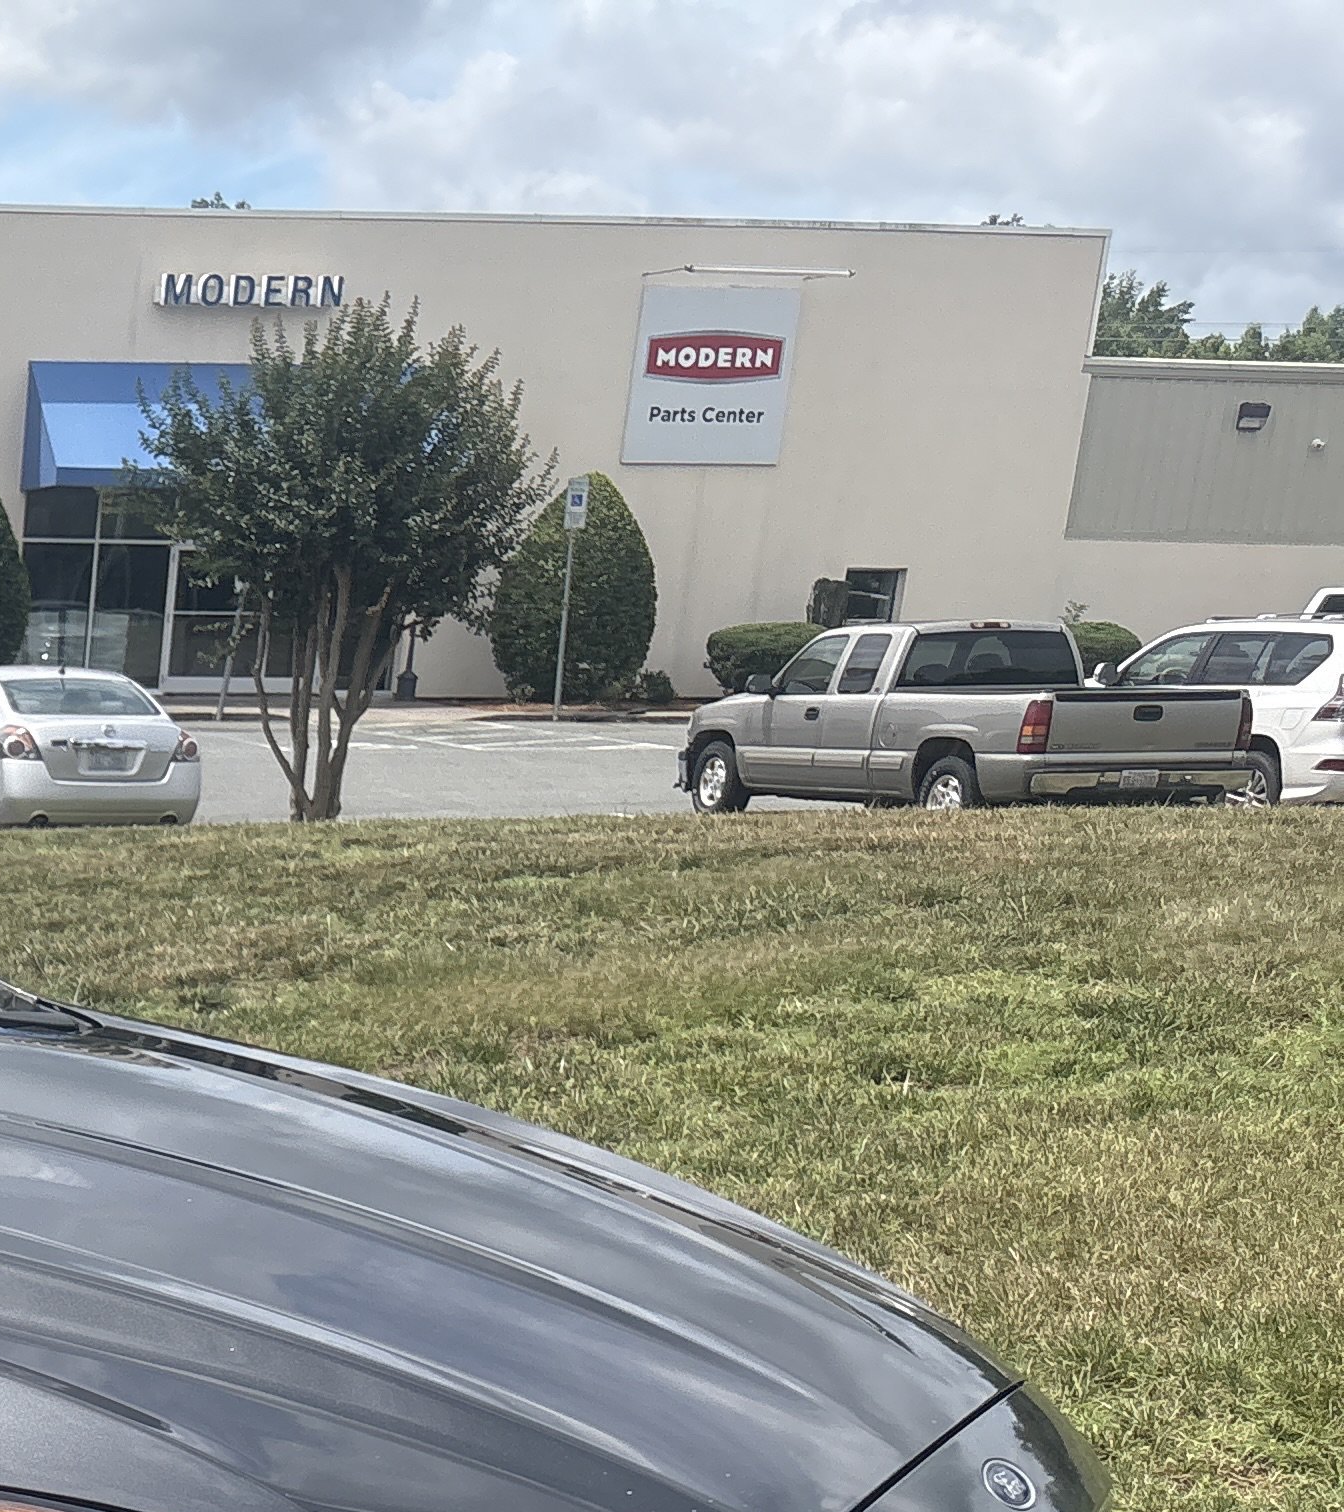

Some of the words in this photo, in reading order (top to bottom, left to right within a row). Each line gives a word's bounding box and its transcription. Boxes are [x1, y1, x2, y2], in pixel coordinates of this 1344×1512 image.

[160, 272, 345, 307] MODERN
[655, 346, 774, 369] MODERN
[648, 406, 696, 423] Parts
[702, 407, 765, 424] Center
